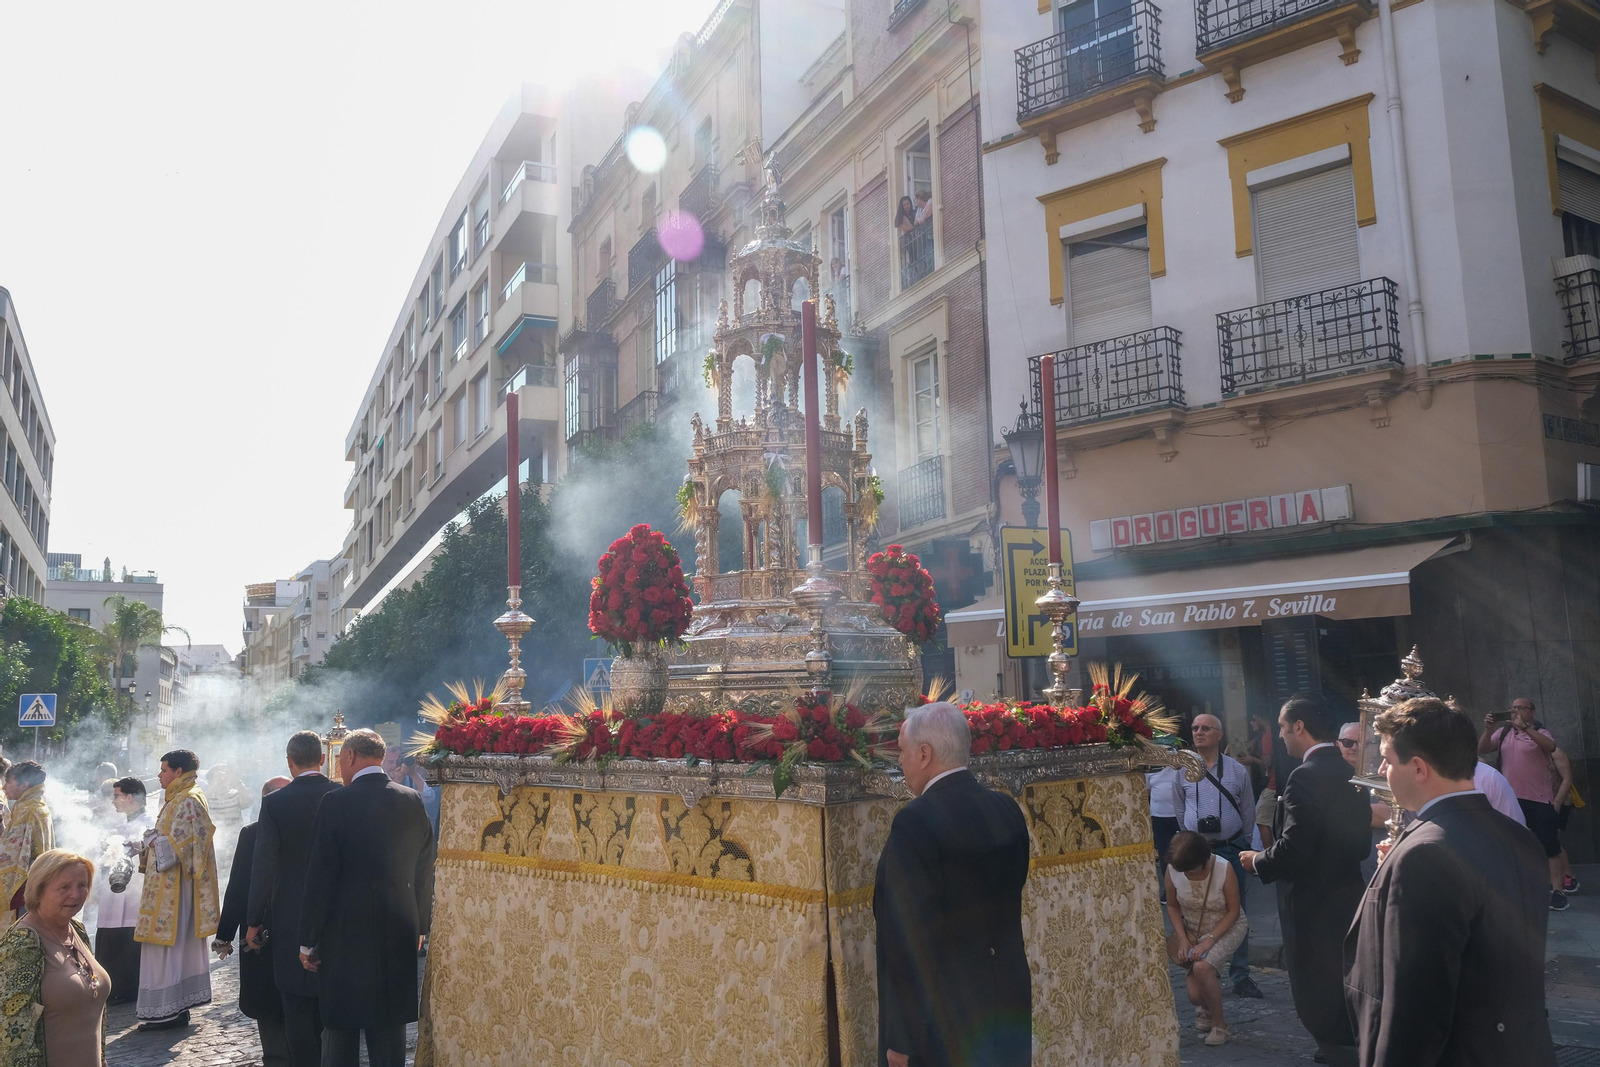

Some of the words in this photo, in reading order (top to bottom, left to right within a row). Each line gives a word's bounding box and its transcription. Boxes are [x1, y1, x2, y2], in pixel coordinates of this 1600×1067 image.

[1112, 493, 1319, 546] DROGUERIA
[1030, 558, 1051, 566] ACCE
[1024, 568, 1047, 576] PLAZA
[1025, 579, 1041, 587] POR
[1111, 611, 1133, 629] de
[1139, 609, 1176, 627] San
[1183, 602, 1237, 623] Pablo
[1242, 600, 1258, 618] 7.
[1267, 594, 1337, 617] Sevilla
